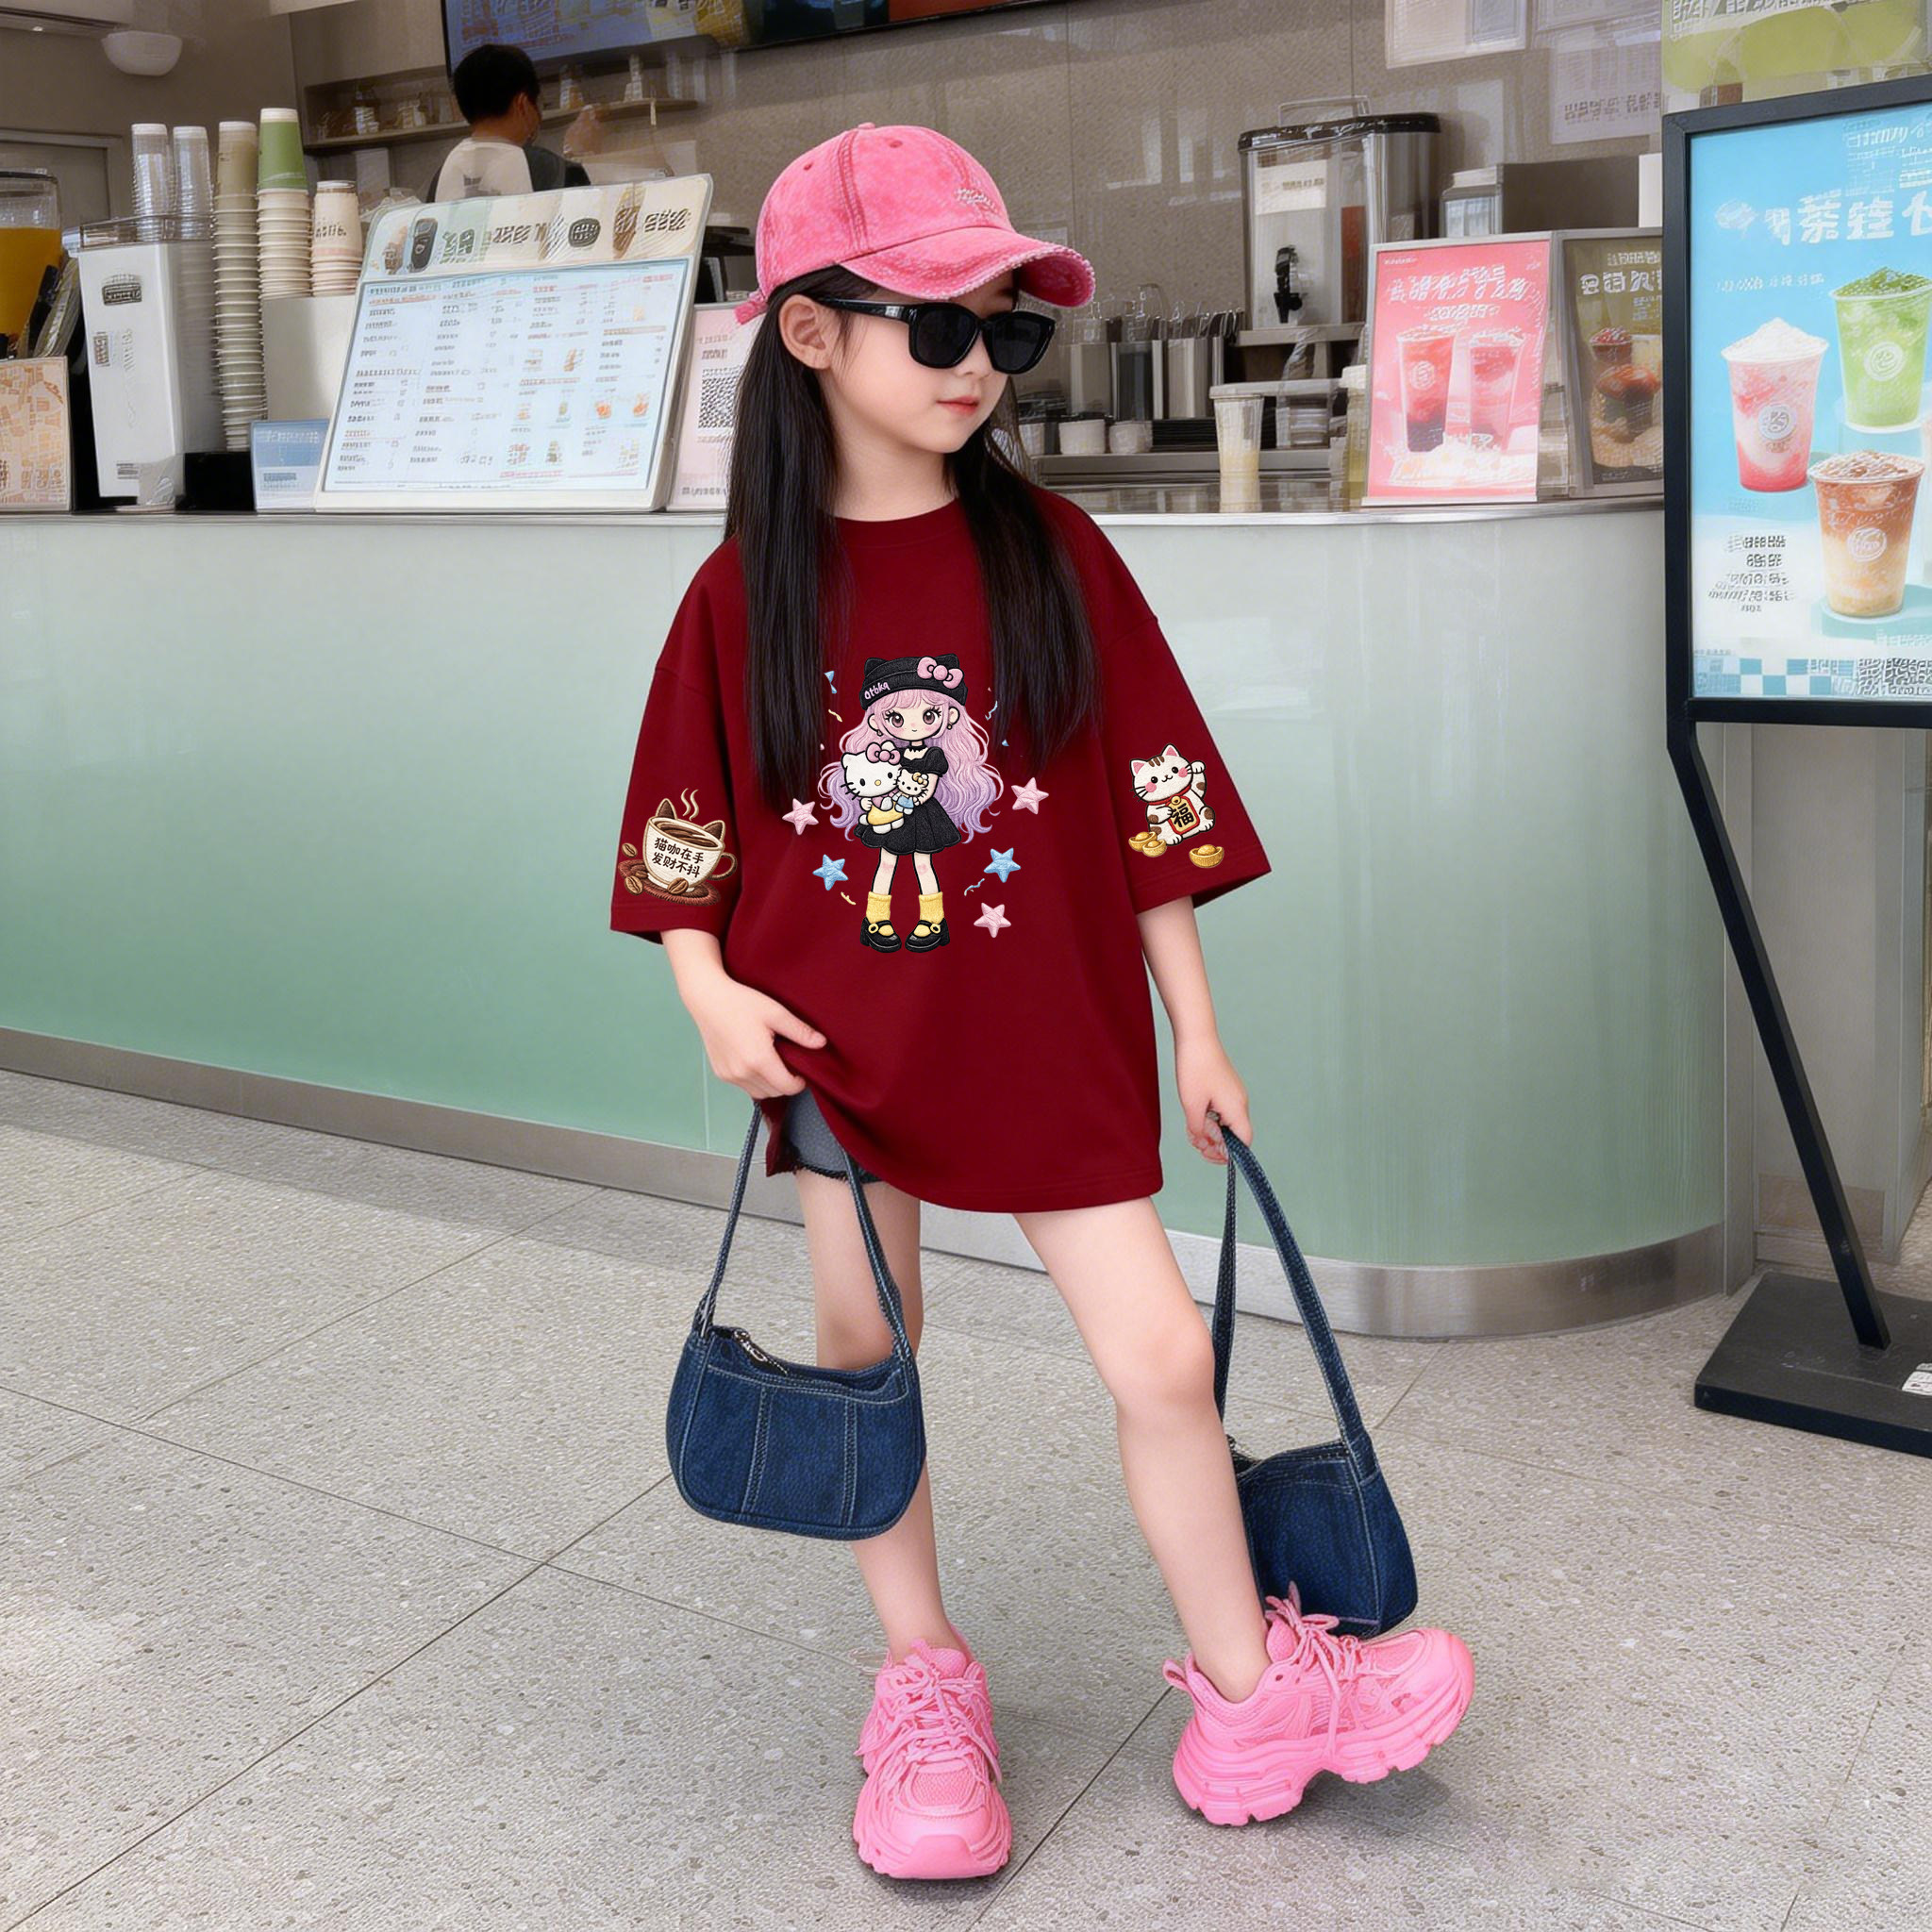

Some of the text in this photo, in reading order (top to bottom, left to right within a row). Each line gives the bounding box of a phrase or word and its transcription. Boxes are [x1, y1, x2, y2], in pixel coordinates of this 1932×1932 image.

[1170, 802, 1194, 827] 福
[655, 837, 705, 864] 猫咖在手
[652, 851, 700, 878] 发财不抖
